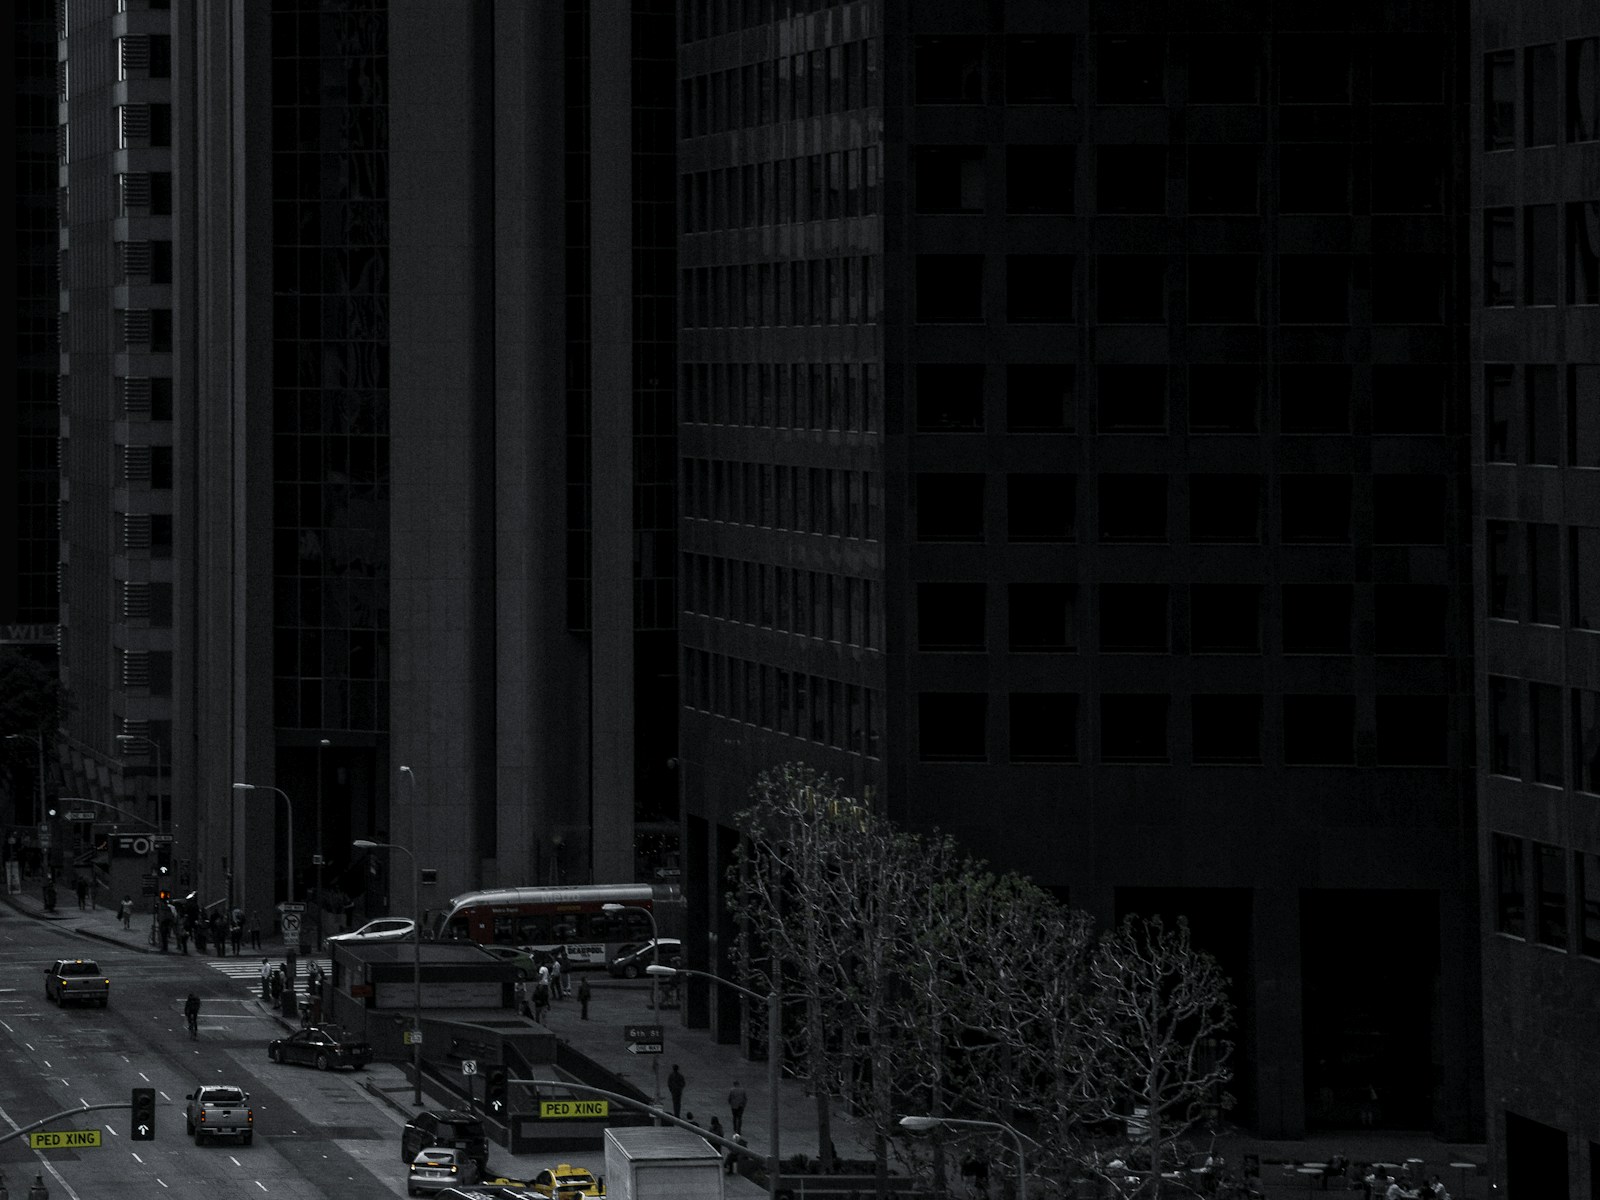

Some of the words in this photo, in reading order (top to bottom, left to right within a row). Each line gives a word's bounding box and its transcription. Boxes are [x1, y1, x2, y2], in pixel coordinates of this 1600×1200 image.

[630, 1028, 645, 1037] 6th
[546, 1103, 569, 1114] PED
[575, 1103, 602, 1113] XING
[36, 1134, 60, 1146] PED
[66, 1133, 95, 1145] XING
